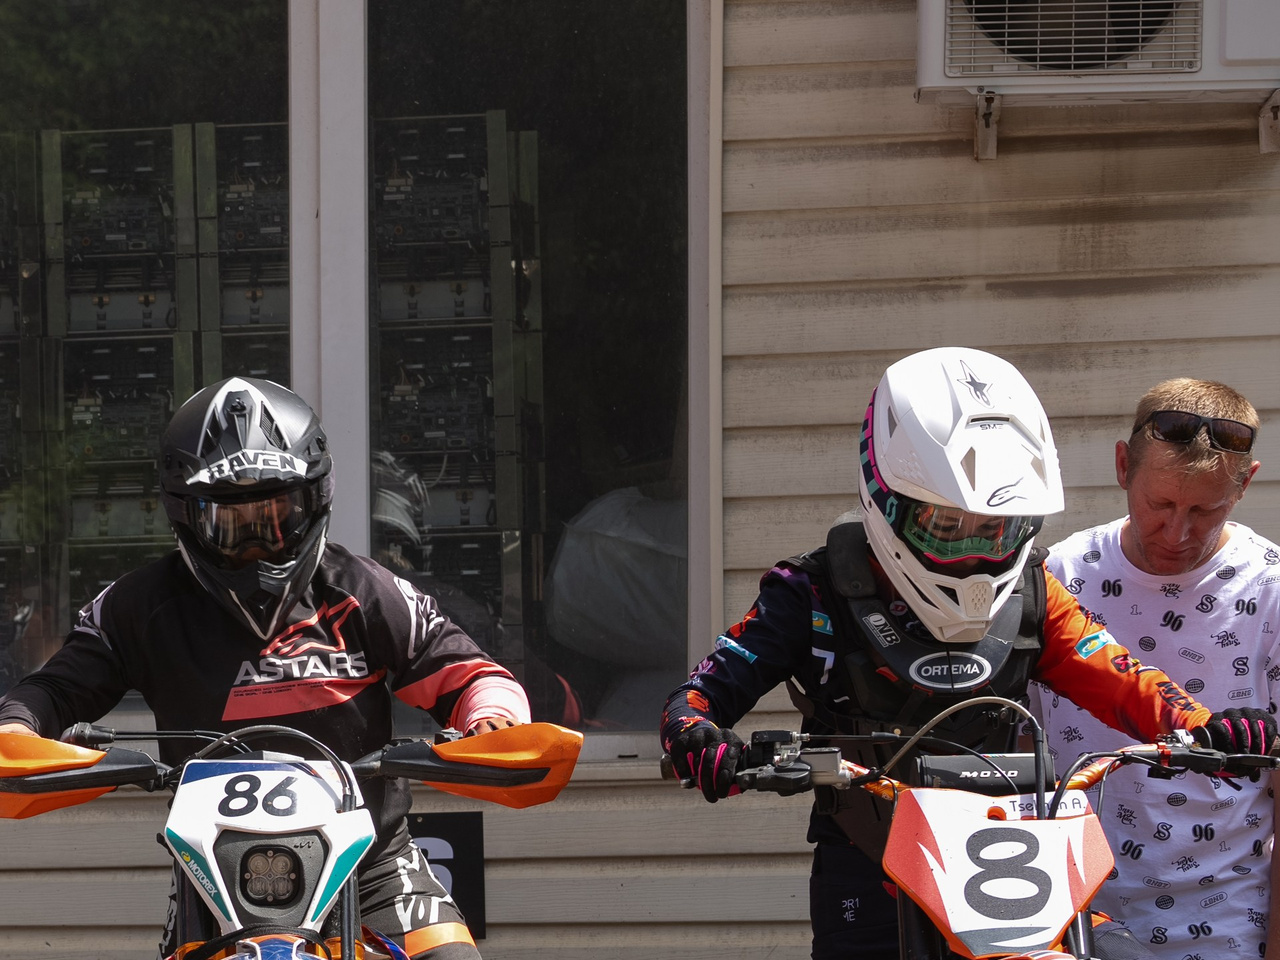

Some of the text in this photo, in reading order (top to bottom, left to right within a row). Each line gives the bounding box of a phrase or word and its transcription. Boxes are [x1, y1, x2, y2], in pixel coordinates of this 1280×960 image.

[207, 451, 297, 479] RAVEN
[1101, 578, 1123, 598] 96
[1196, 593, 1217, 613] S
[1235, 596, 1257, 617] 96
[1160, 610, 1186, 632] 96
[233, 651, 369, 686] ASTARS
[921, 663, 981, 677] ORTEMA
[1232, 656, 1250, 677] S
[218, 774, 299, 818] 86
[1009, 797, 1086, 812] Tseln A.
[1153, 822, 1173, 841] S
[1191, 823, 1216, 842] 96
[1120, 840, 1145, 861] 96
[187, 860, 218, 898] MOTOREX
[963, 827, 1053, 921] 8
[1150, 926, 1168, 944] S
[1187, 921, 1214, 940] 96
